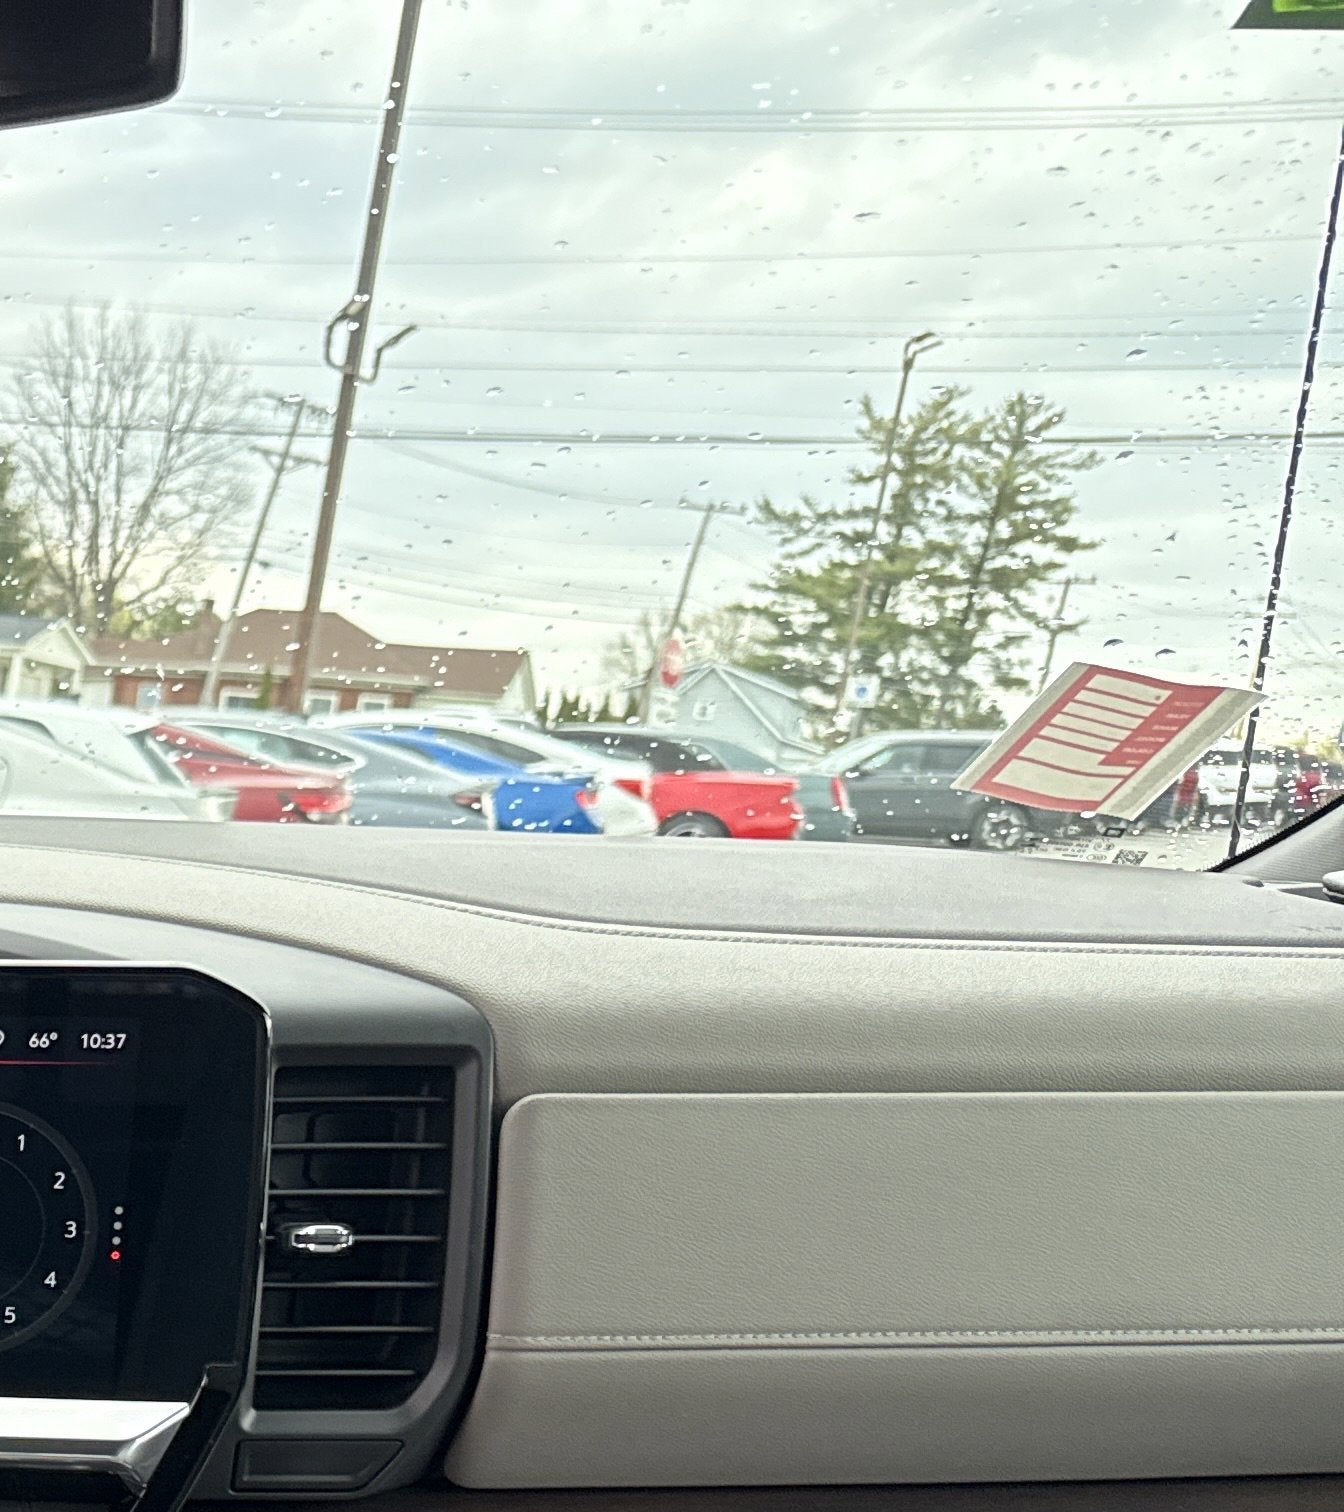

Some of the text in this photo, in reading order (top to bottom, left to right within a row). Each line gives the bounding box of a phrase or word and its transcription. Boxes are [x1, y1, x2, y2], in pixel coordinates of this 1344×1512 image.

[80, 1033, 127, 1050] 10:37
[17, 1134, 26, 1152] 1
[53, 1172, 66, 1190] 2
[64, 1221, 77, 1239] 3
[44, 1271, 57, 1288] 4
[4, 1306, 17, 1325] 5
